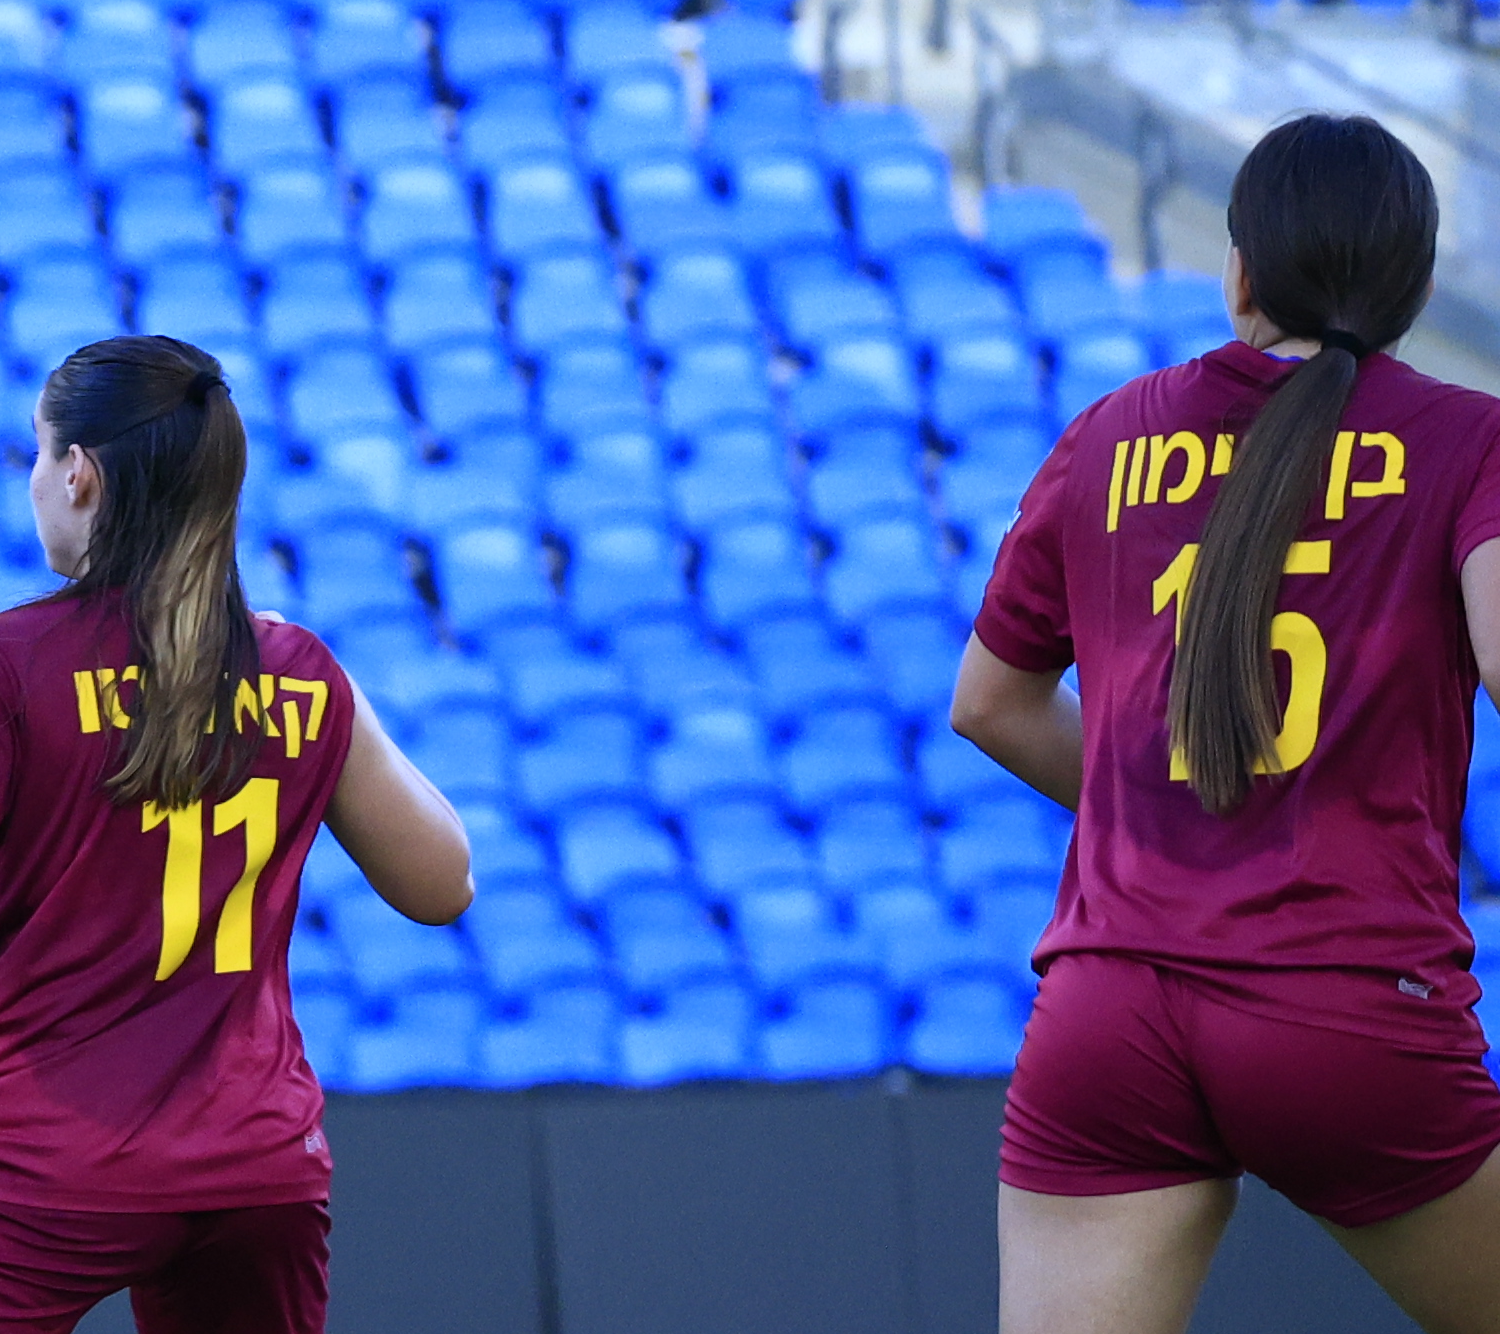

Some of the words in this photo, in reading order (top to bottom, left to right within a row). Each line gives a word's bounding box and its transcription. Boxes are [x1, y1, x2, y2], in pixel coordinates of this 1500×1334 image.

[1105, 430, 1238, 534] ימון
[1324, 430, 1406, 521] בן
[141, 777, 280, 982] 11
